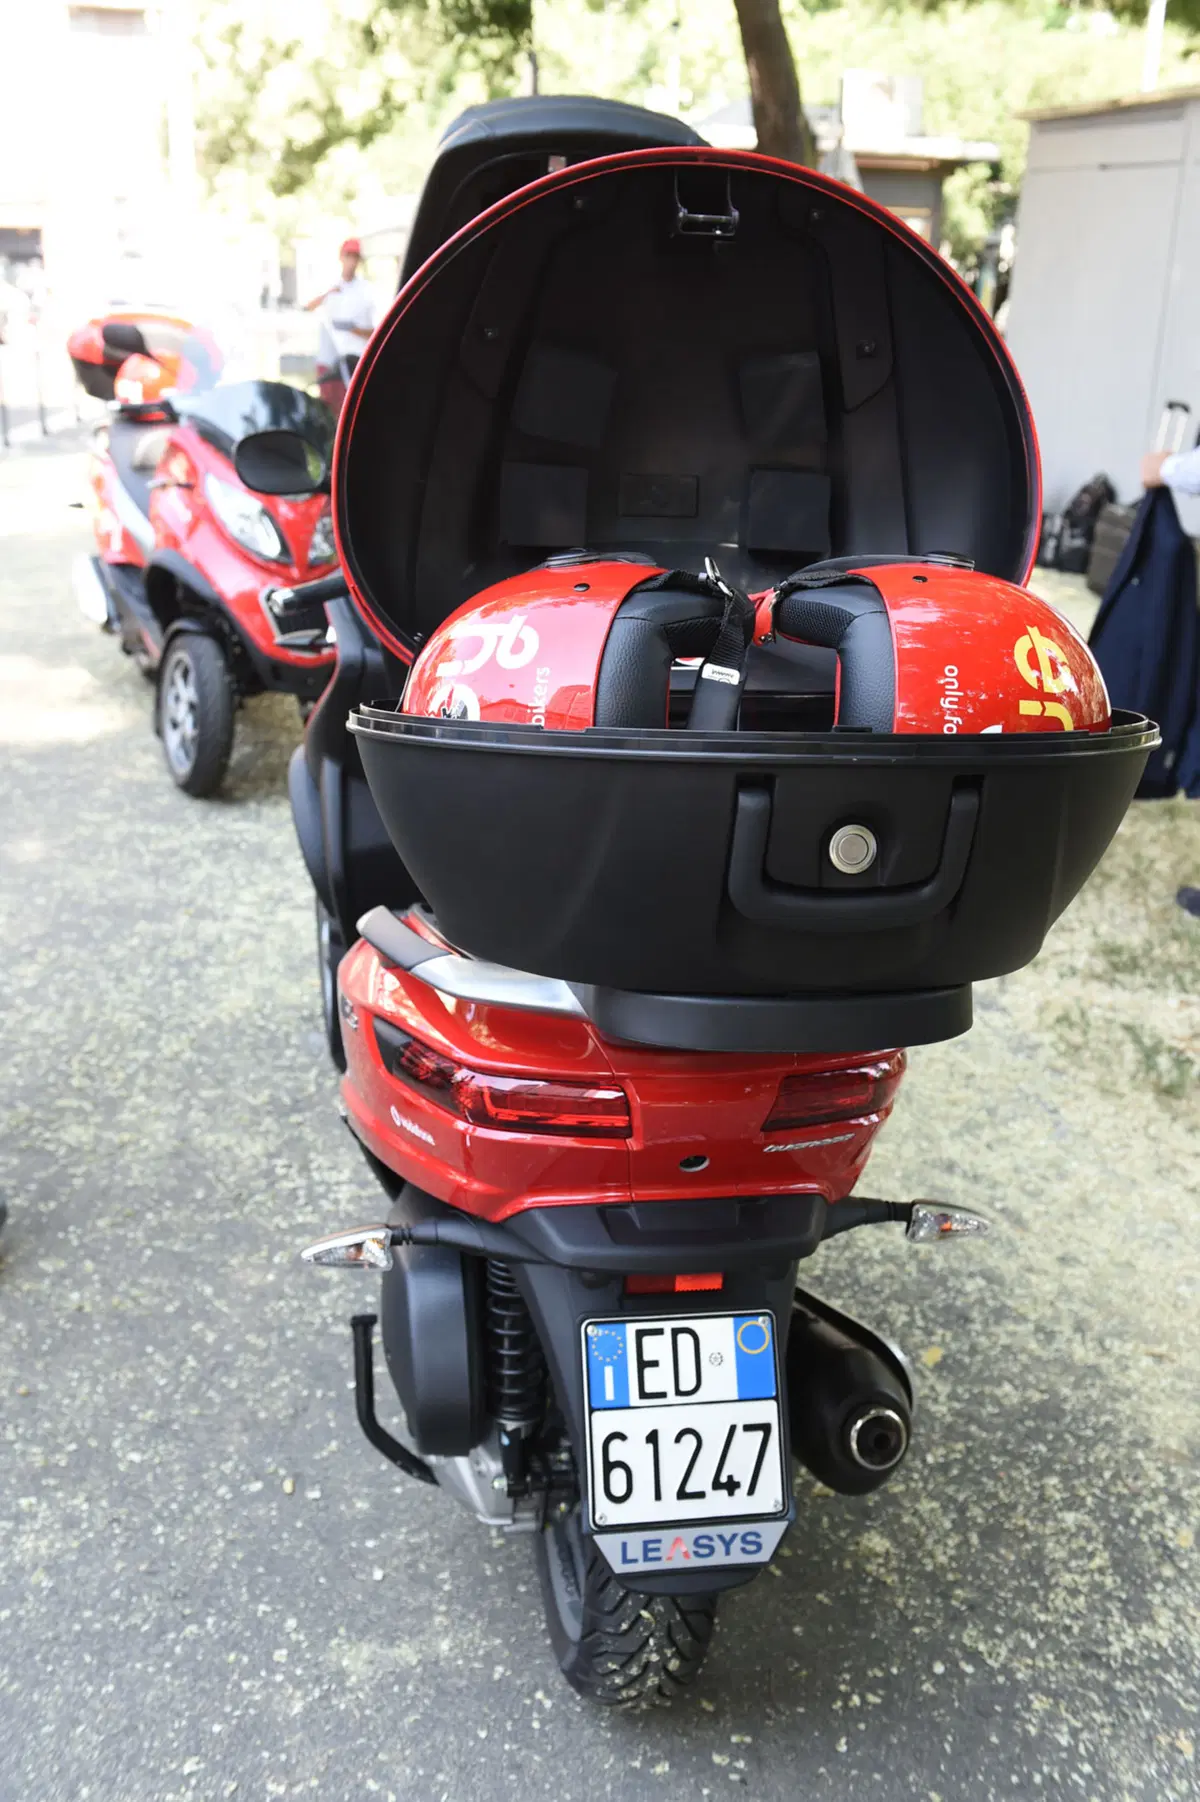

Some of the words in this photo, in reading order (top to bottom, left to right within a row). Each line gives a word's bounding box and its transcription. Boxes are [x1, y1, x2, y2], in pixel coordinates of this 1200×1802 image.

[527, 666, 551, 727] bikers
[940, 664, 964, 710] only
[635, 1326, 702, 1400] ED
[602, 1422, 772, 1504] 61247
[621, 1531, 763, 1565] LEASYS
